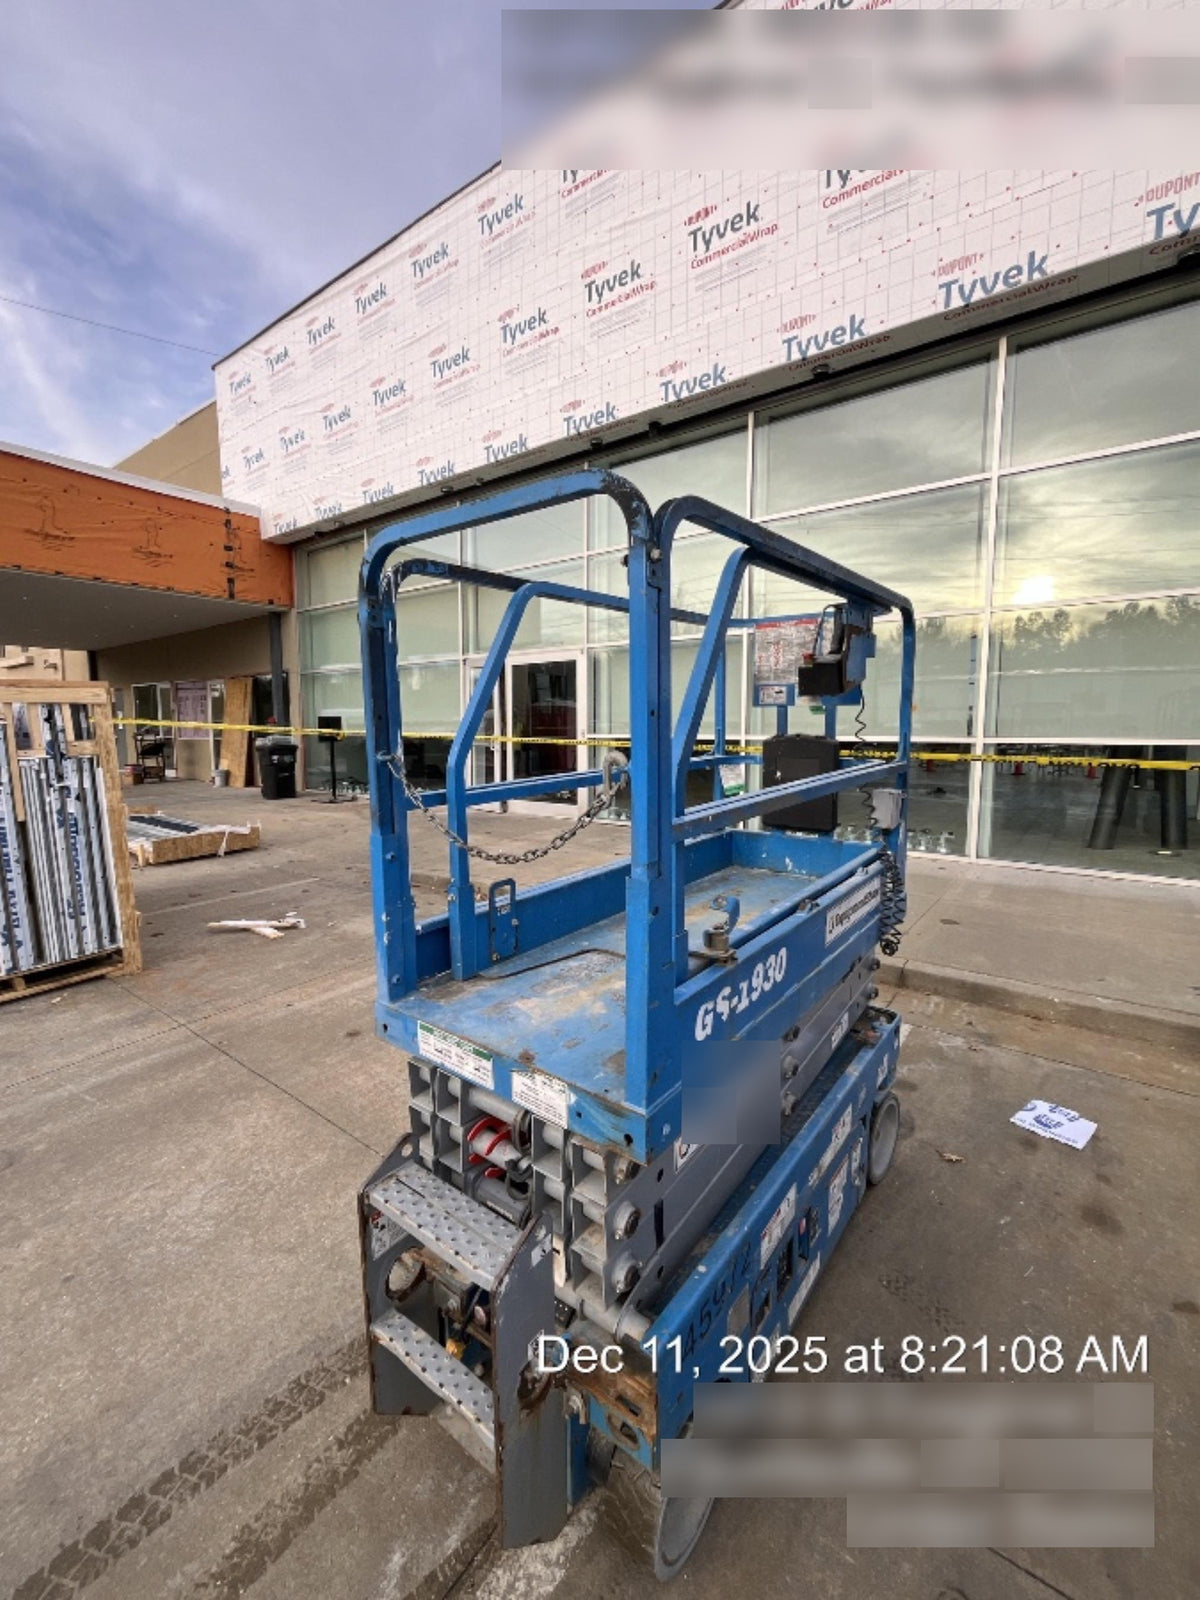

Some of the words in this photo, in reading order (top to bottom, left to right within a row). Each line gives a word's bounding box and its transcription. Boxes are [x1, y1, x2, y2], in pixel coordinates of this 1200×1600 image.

[478, 193, 524, 236] Tyvek
[688, 200, 761, 255] Tyvek
[411, 242, 449, 279] Tyvek
[585, 259, 642, 304] Tyvek
[938, 250, 1049, 312] Tyvek
[355, 282, 387, 315] Tyvek
[307, 317, 336, 345] Tyvek
[500, 306, 548, 345] Tyvek
[782, 314, 866, 362] Tyvek
[265, 347, 290, 372] Tyvek
[429, 345, 471, 379] Tyvek
[372, 379, 407, 406] Tyvek
[660, 362, 727, 402] Tyvek
[323, 405, 350, 431] Tyvek
[564, 402, 616, 436] Tyvek
[484, 433, 528, 463] Tyvek
[418, 460, 455, 487] Tyvek
[363, 482, 394, 504] Tyvek
[695, 946, 787, 1041] GS-1930
